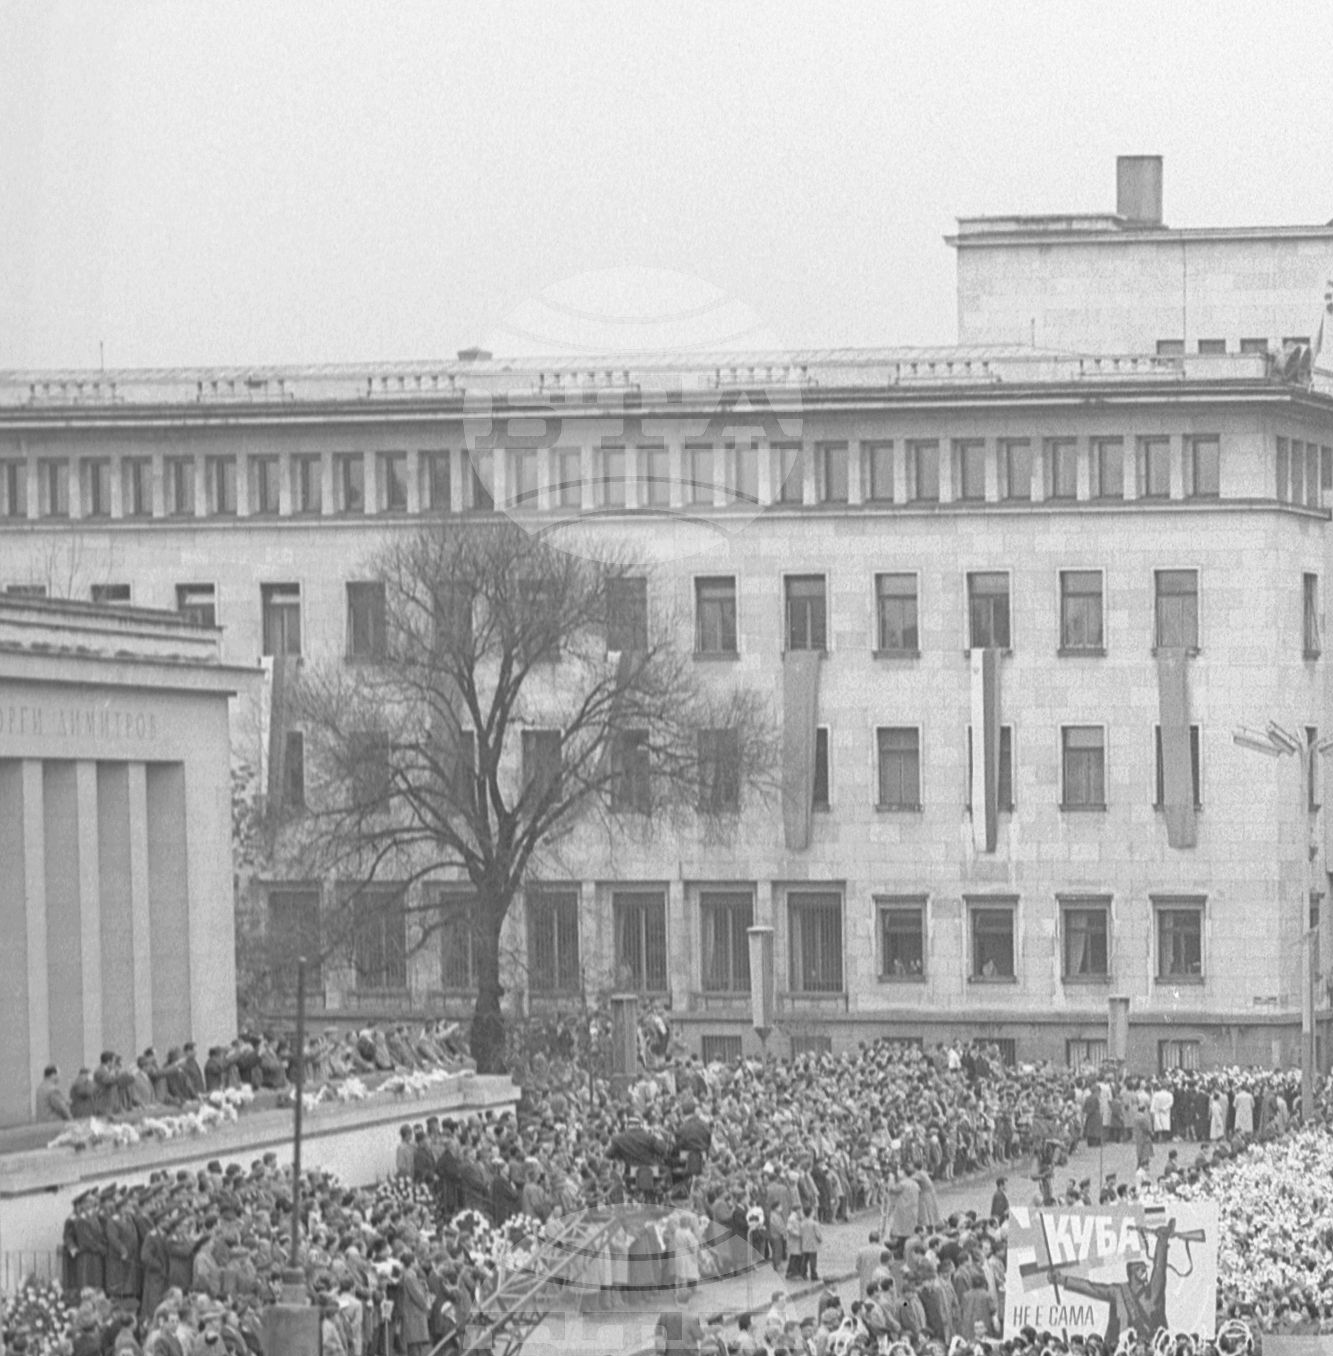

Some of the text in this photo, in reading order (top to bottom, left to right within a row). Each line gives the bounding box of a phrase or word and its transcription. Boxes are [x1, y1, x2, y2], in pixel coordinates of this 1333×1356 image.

[55, 708, 157, 740] ДИМИТРОВ
[1043, 1214, 1142, 1263] КУБА
[1013, 1306, 1031, 1326] НЕ
[1049, 1305, 1094, 1326] САМА
